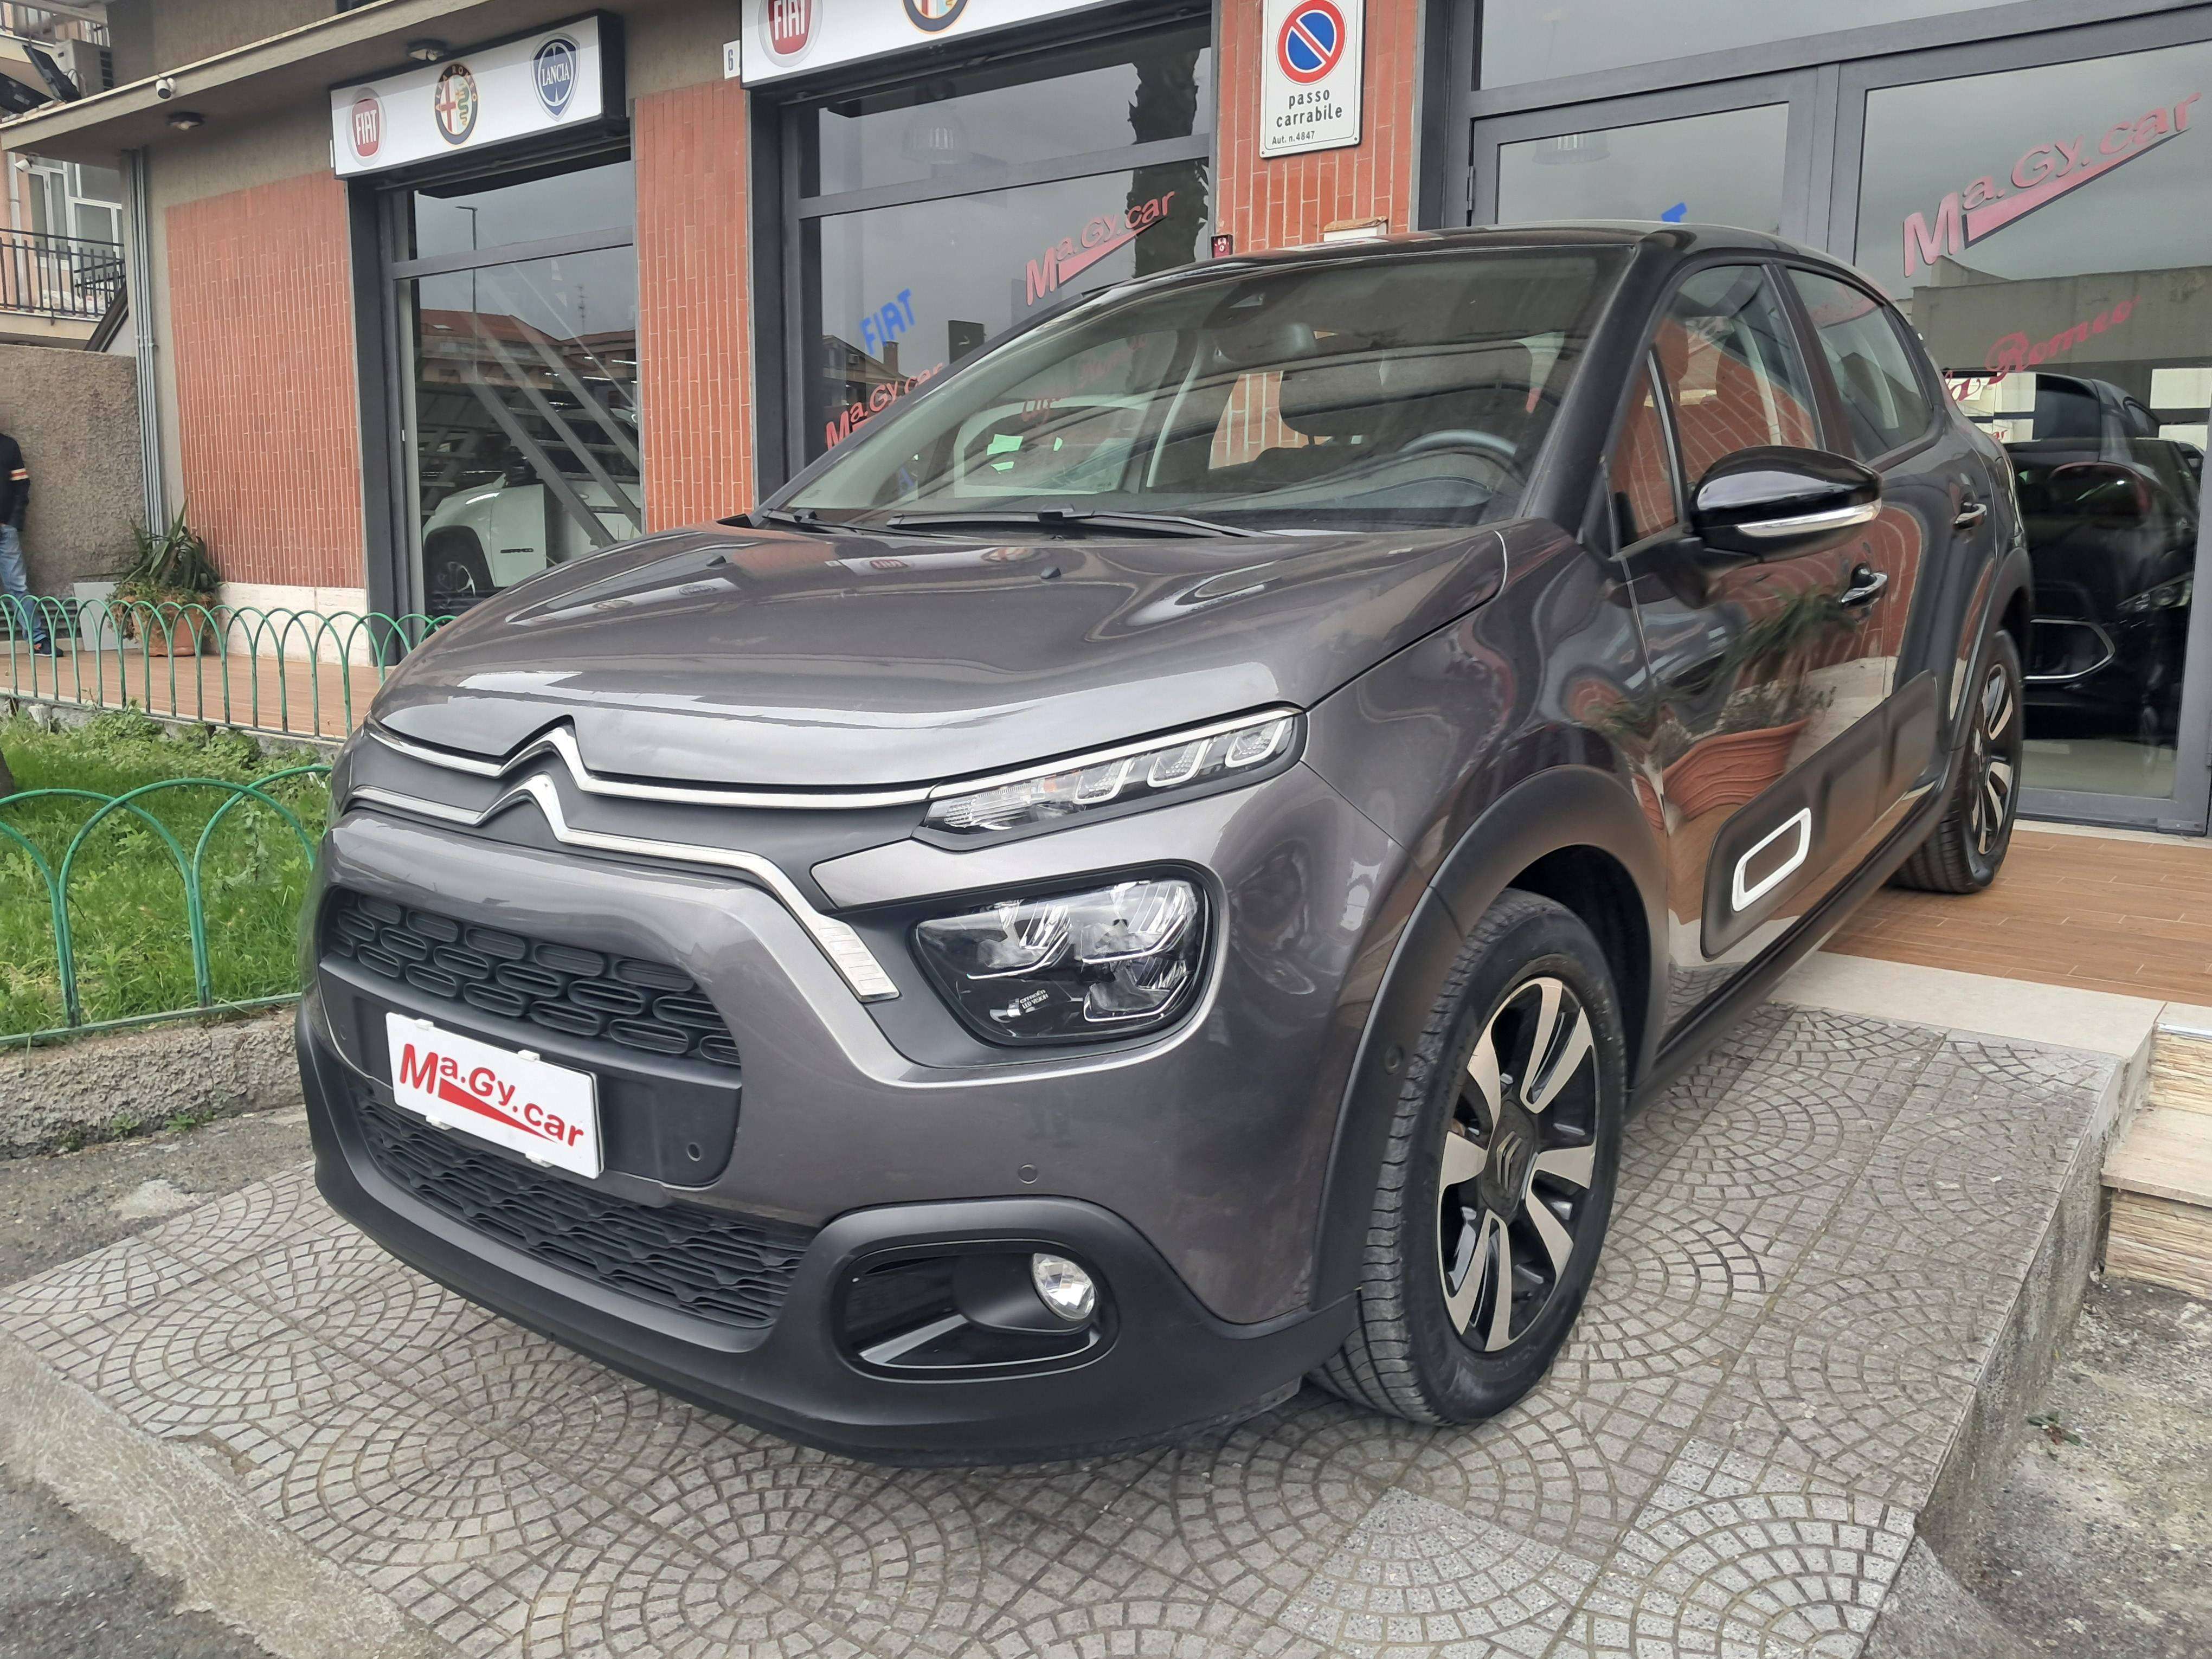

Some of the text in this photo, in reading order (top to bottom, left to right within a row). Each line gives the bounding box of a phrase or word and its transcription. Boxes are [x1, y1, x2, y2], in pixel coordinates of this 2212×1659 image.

[542, 62, 570, 87] LANCIA
[1288, 89, 1330, 110] passo
[355, 108, 377, 146] FIAT
[1276, 103, 1342, 128] carrabile
[1272, 135, 1287, 145] Aut.
[859, 287, 917, 356] FIAT
[1984, 295, 2142, 385] Romeo
[399, 1043, 584, 1147] Ma.Gy.car
